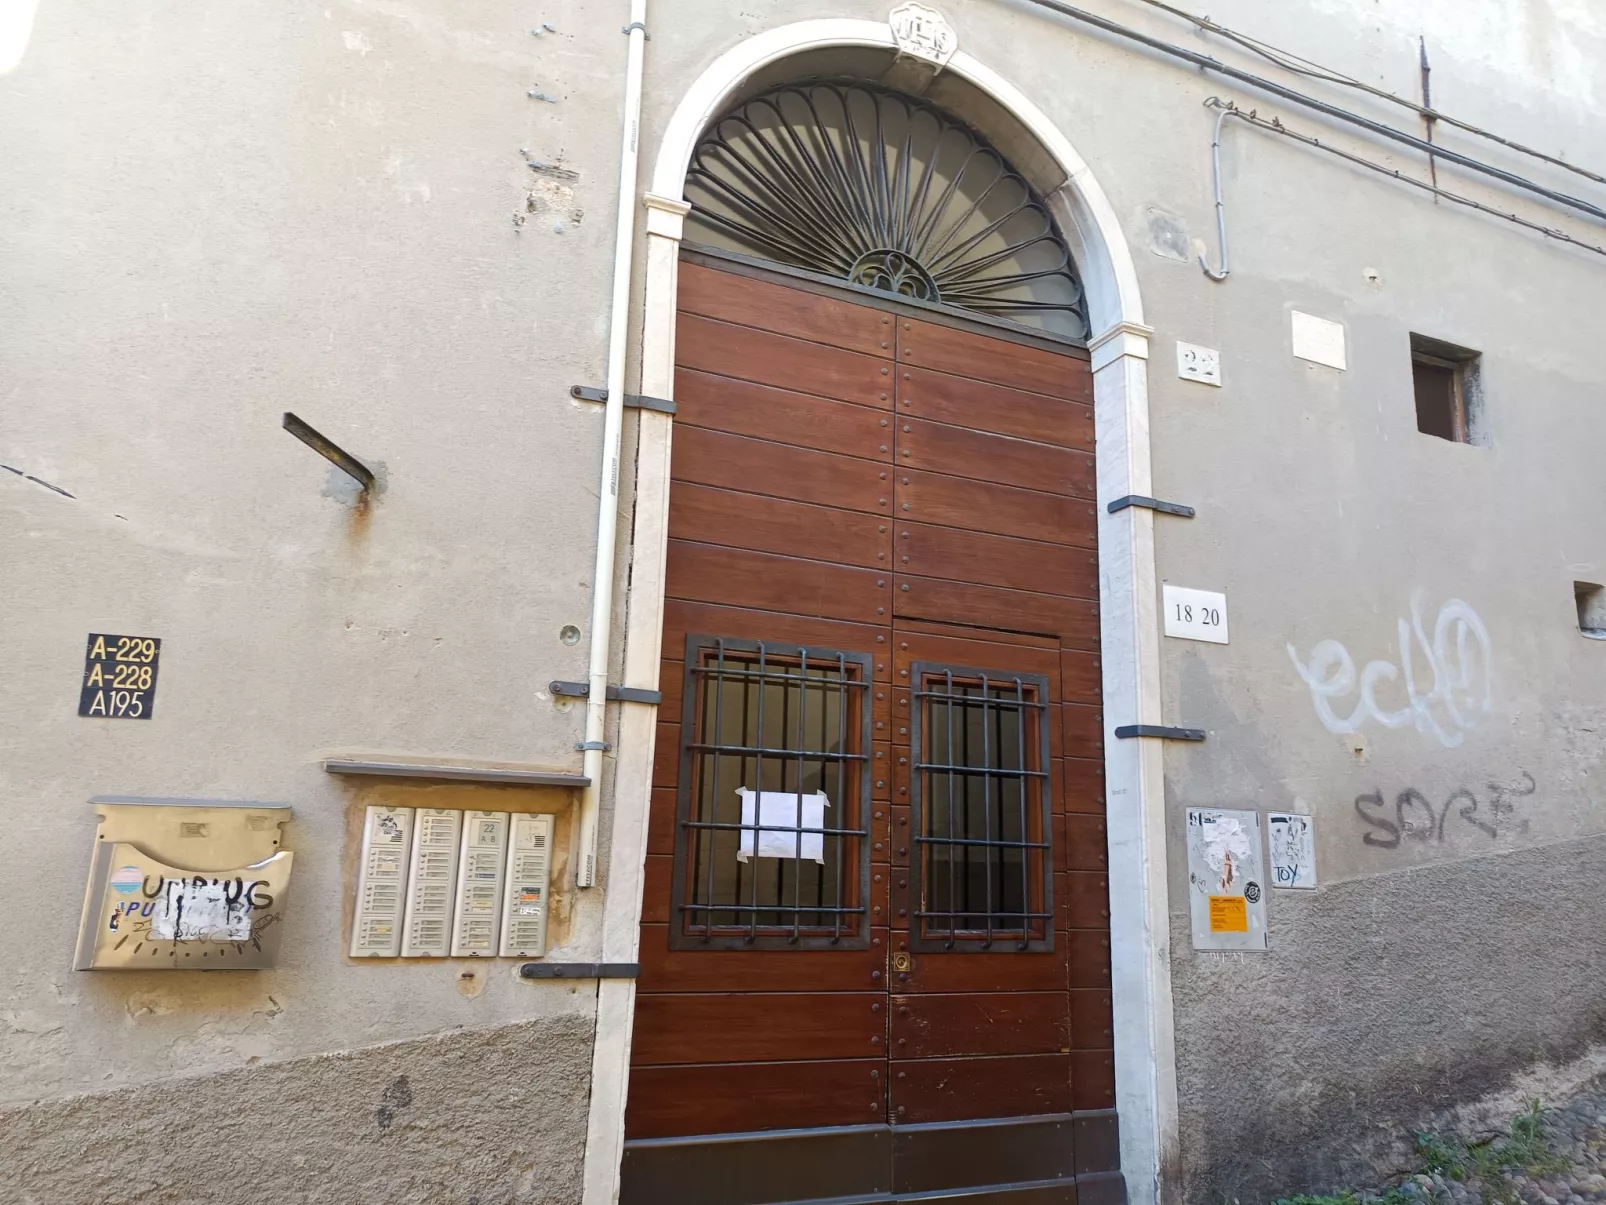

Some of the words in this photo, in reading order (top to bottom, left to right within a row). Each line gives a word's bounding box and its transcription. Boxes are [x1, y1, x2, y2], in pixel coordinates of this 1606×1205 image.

[1184, 349, 1215, 376] 22
[1176, 604, 1193, 623] 18
[1201, 607, 1220, 627] 20
[90, 635, 155, 663] A-229
[87, 663, 152, 690] A-228
[88, 689, 144, 717] A195
[483, 823, 495, 833] 22
[1273, 863, 1298, 888] TOY
